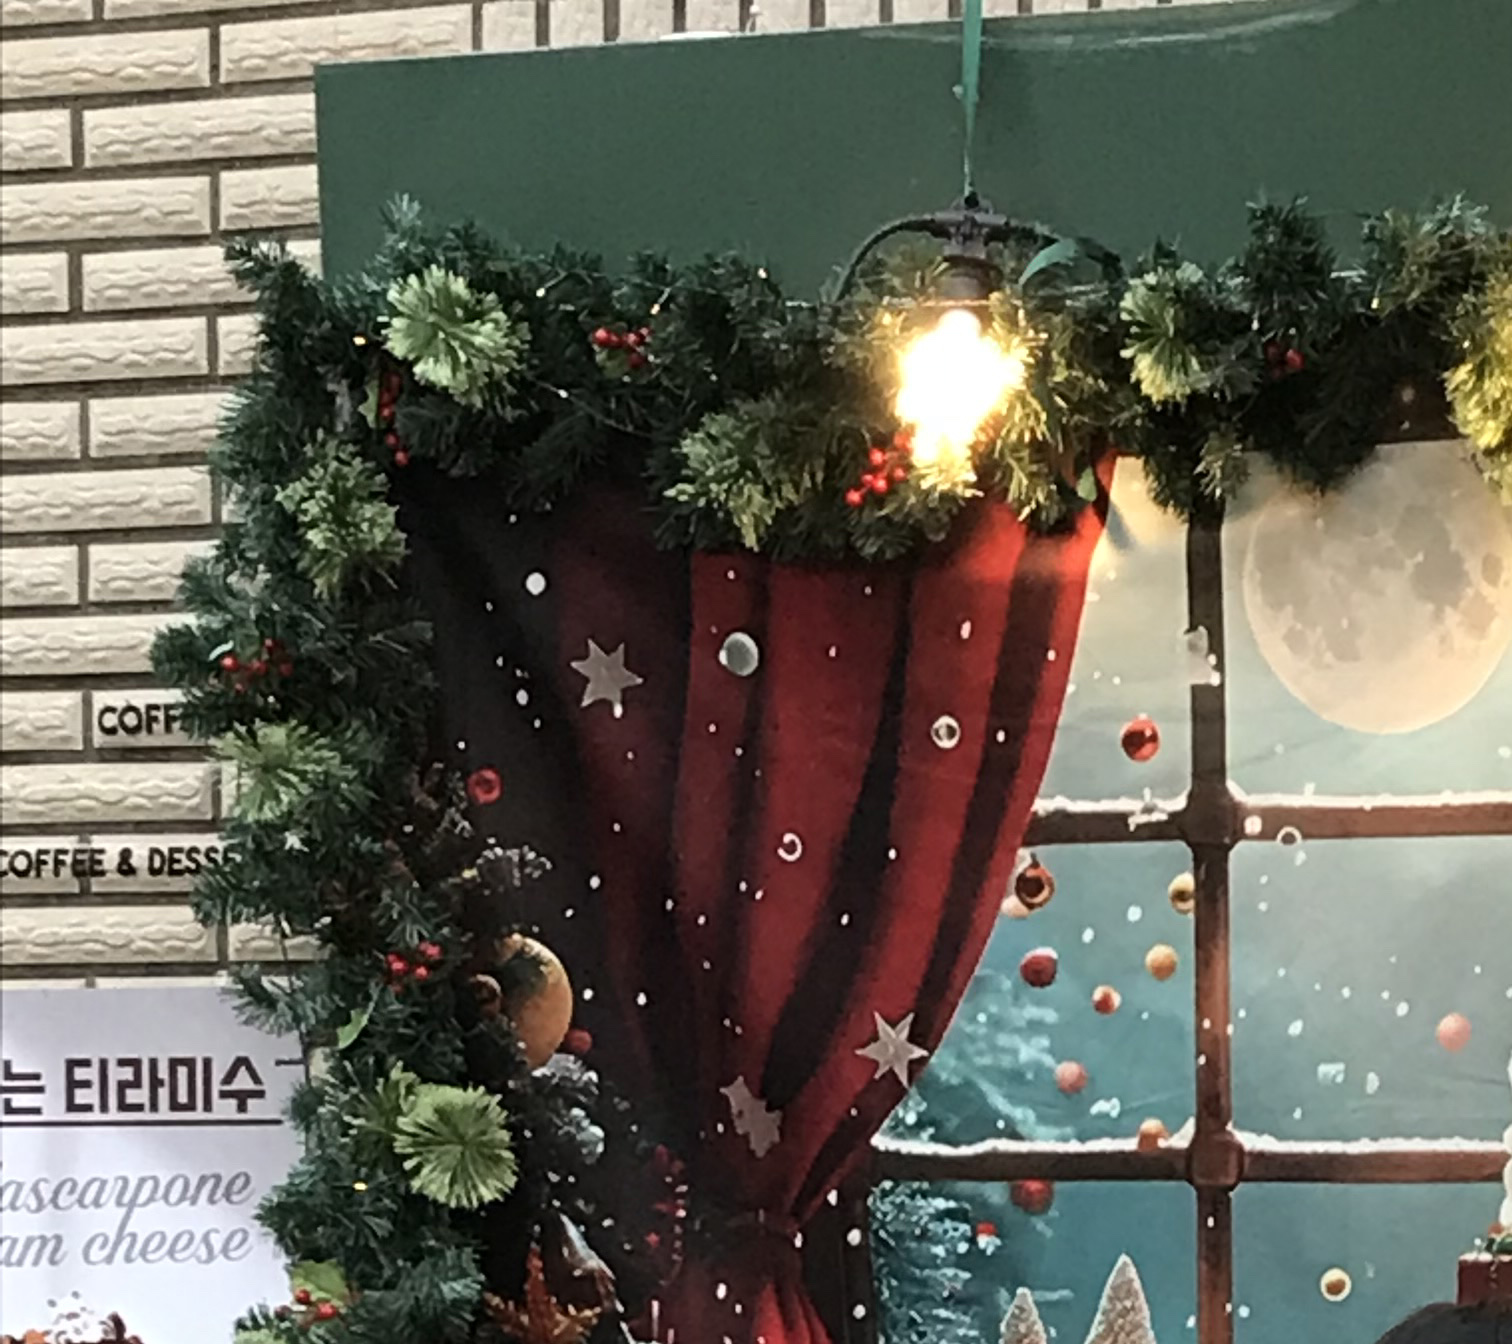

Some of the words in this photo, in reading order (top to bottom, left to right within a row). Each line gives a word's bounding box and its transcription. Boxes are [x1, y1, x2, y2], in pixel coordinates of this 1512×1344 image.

[98, 703, 183, 736] COFF
[116, 846, 137, 876] &
[0, 1058, 45, 1116] 는
[64, 1056, 266, 1114] 티라미수
[0, 1168, 254, 1226] ascarpone
[82, 1205, 252, 1267] cheese
